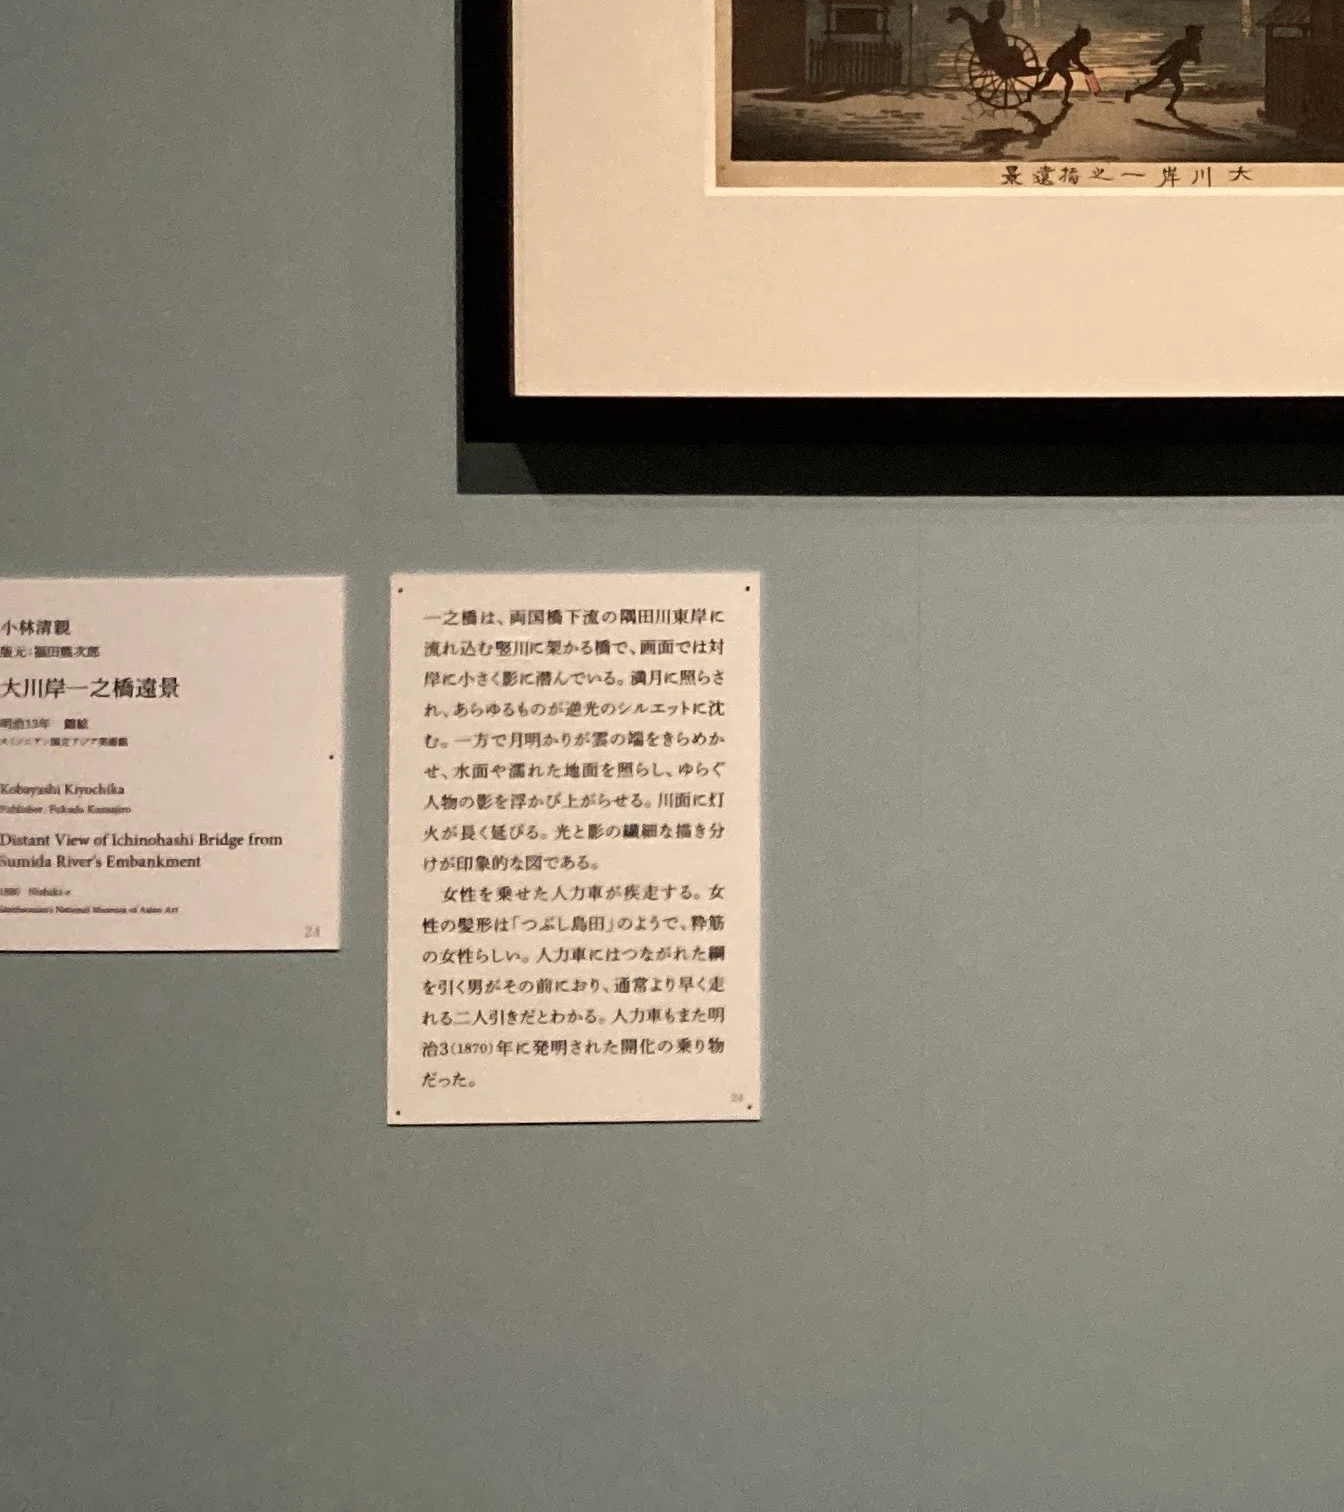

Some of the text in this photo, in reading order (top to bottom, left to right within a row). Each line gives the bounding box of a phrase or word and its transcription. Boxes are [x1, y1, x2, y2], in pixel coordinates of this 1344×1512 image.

[1, 619, 71, 636] 小林清親
[1, 676, 180, 700] 大川岸一之橋遠景
[0, 831, 283, 851] Distant View of Ichinohashi Bridge from
[0, 853, 201, 869] Sumida River's Embankment
[423, 854, 599, 873] けが印象的な図である。
[420, 1070, 477, 1089] だった。
